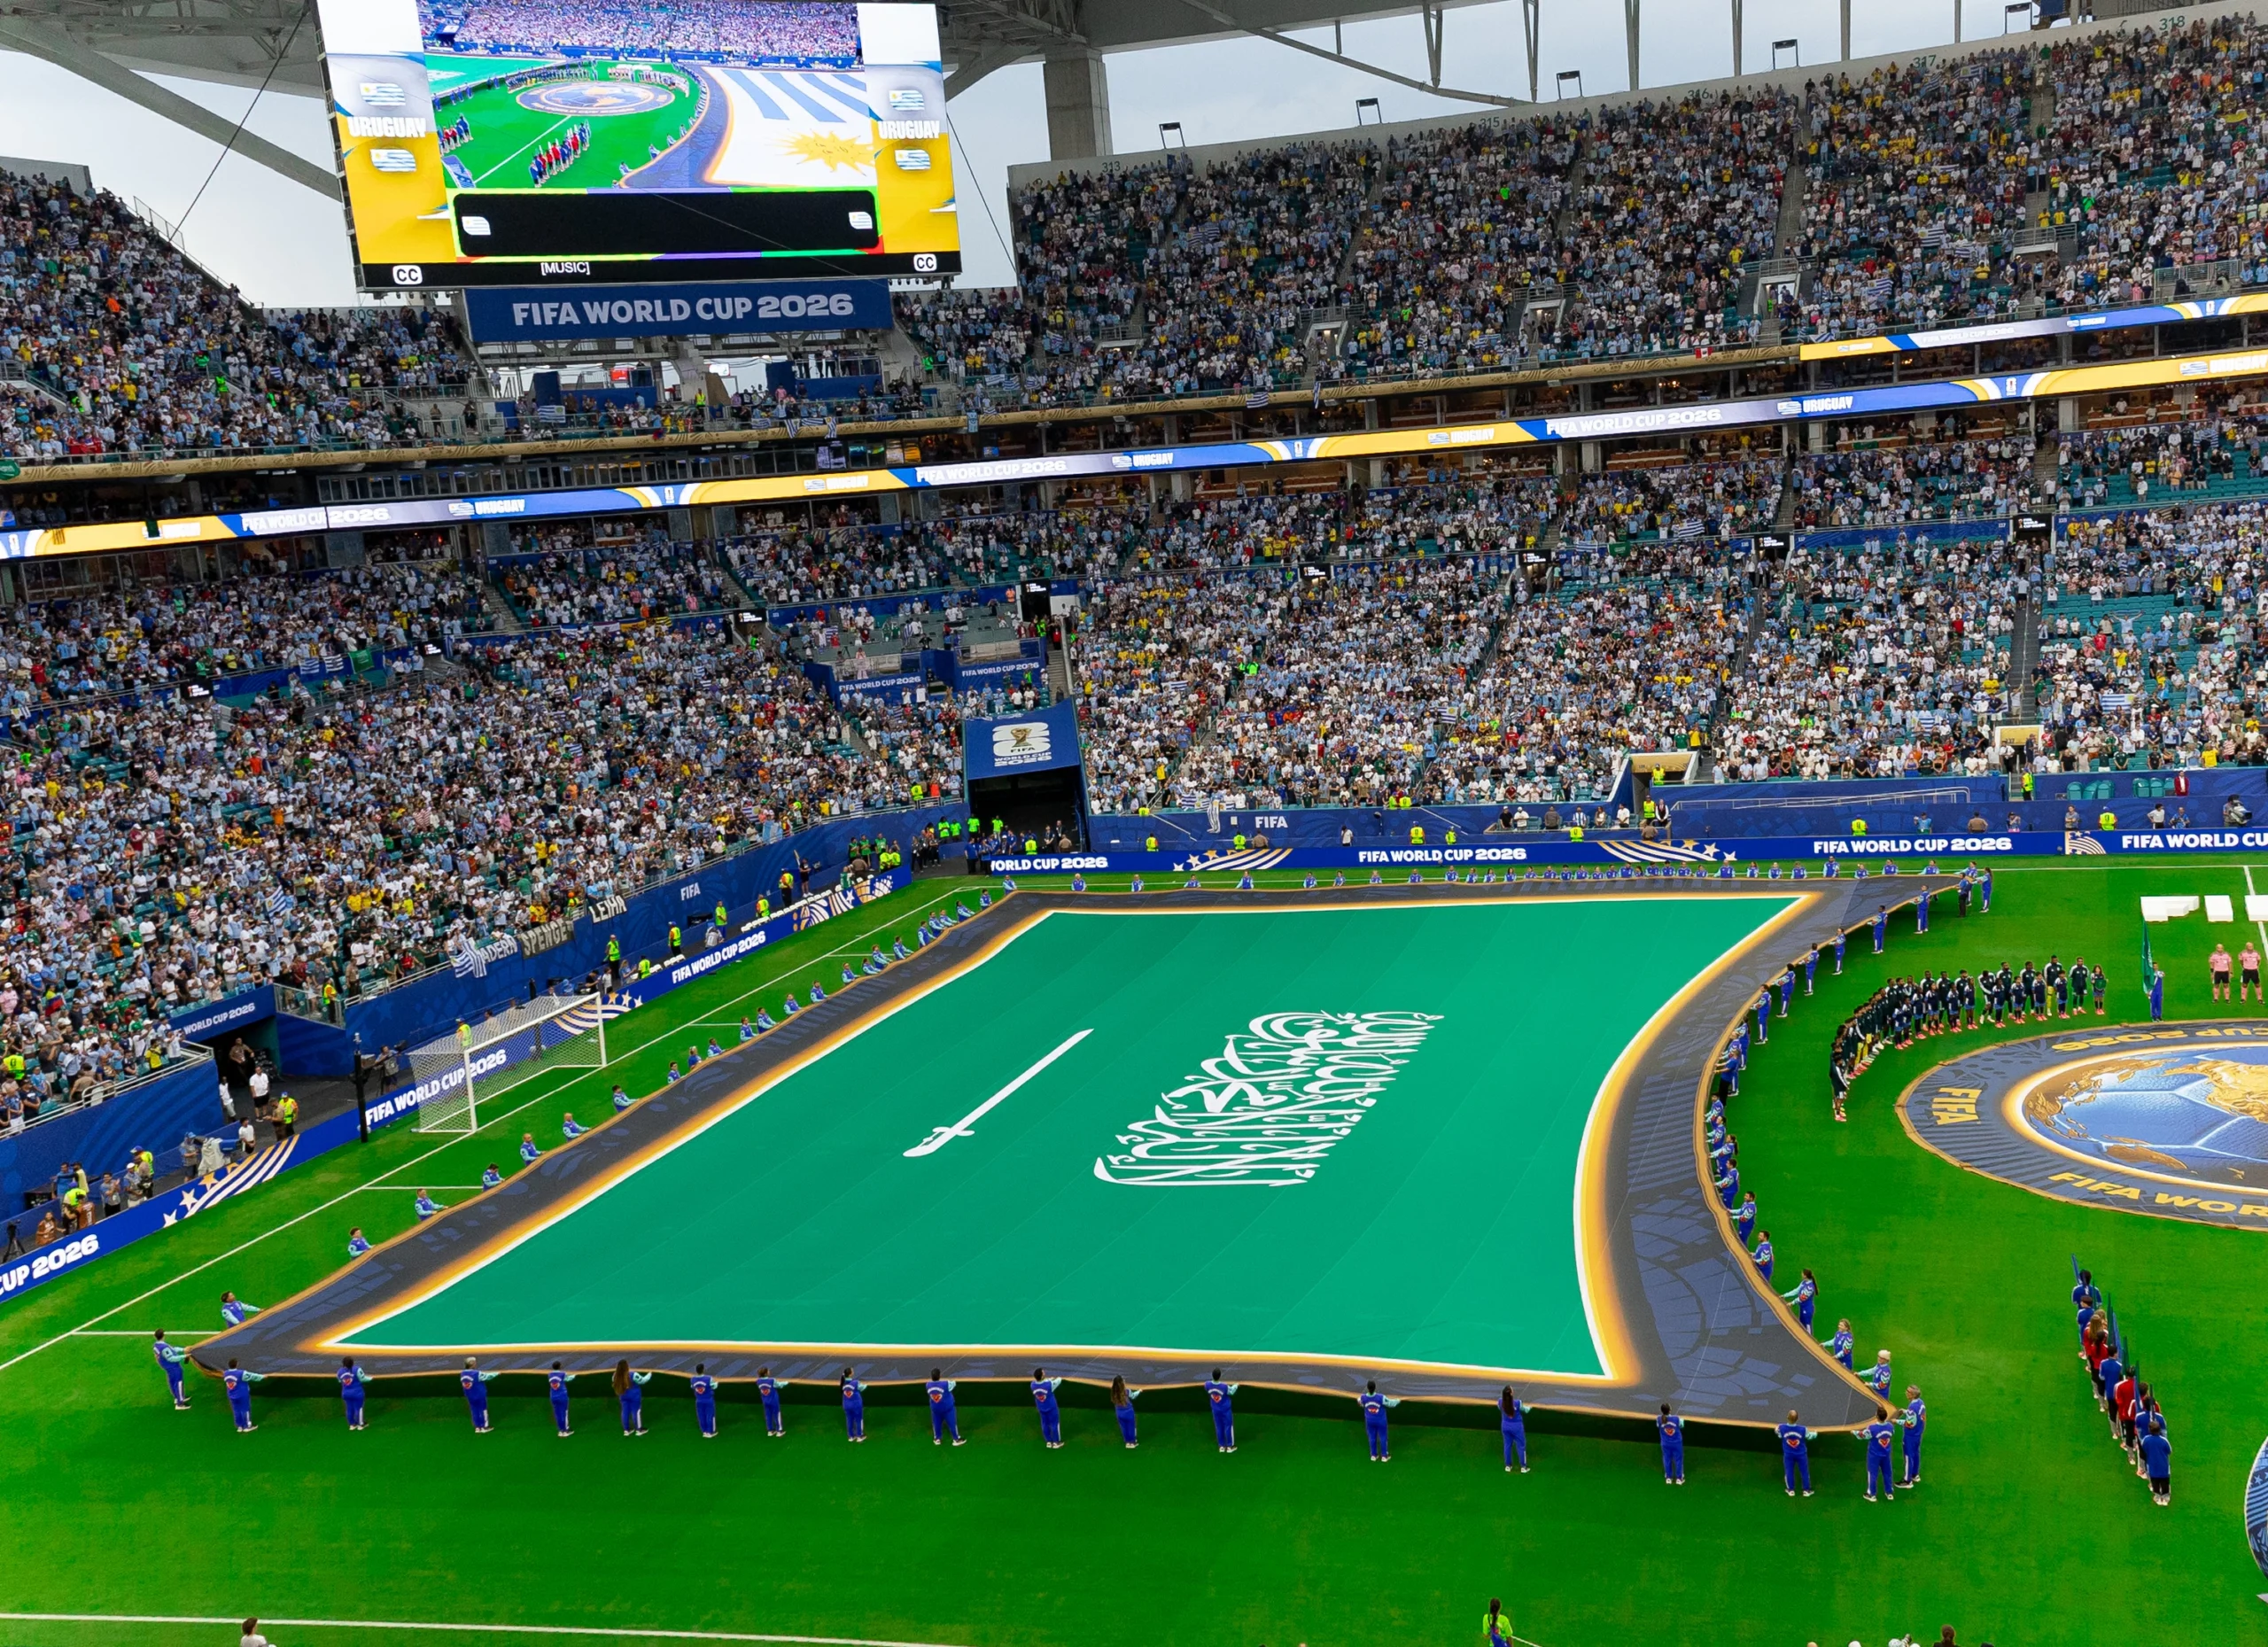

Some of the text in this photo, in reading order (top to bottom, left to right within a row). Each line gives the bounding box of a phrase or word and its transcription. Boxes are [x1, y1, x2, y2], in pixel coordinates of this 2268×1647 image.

[346, 116, 426, 138] URUGUAY
[877, 120, 940, 140] URUGUAY
[540, 261, 591, 276] [MUSIC]
[916, 257, 935, 269] CC
[396, 268, 419, 283] CC
[513, 294, 854, 326] FIFA WORLD CUP 2026
[1802, 395, 1853, 413] URUGUAY
[1546, 408, 1722, 435] FIFA WORLD CUP 2026
[1450, 427, 1495, 444] URUGUAY
[1132, 452, 1174, 467] URUGUAY
[916, 460, 1068, 483] FIFA WORLD CUP 2026
[475, 499, 525, 516] URUGUAY
[268, 513, 307, 529] WORLD
[328, 508, 391, 524] 2026
[961, 662, 1040, 678] FIFA WORLD CUP 2026
[855, 680, 882, 691] WORLD
[882, 678, 896, 687] CUP
[896, 676, 921, 685] 2026
[1254, 816, 1288, 828] FIFA
[1814, 838, 2012, 853] FIFA WORLD CUP 2026
[2122, 835, 2164, 849] FIFA
[2166, 834, 2240, 848] WORLD
[1033, 858, 1060, 870] CUP
[1060, 857, 1107, 869] 2026
[1359, 848, 1527, 863] FIFA WORLD CUP 2026
[680, 882, 701, 901] FIFA
[672, 930, 766, 984] FIFA WORLD CUP 2026
[183, 1018, 213, 1035] WORLD
[213, 1013, 229, 1025] CUP
[229, 1002, 256, 1020] 2026
[365, 1100, 395, 1127] FIFA
[394, 1079, 441, 1112] WORLD
[441, 1068, 466, 1092] CUP
[1931, 1087, 1983, 1126] FIFA
[2048, 1172, 2141, 1200] FIFA
[32, 1234, 99, 1279] 2026
